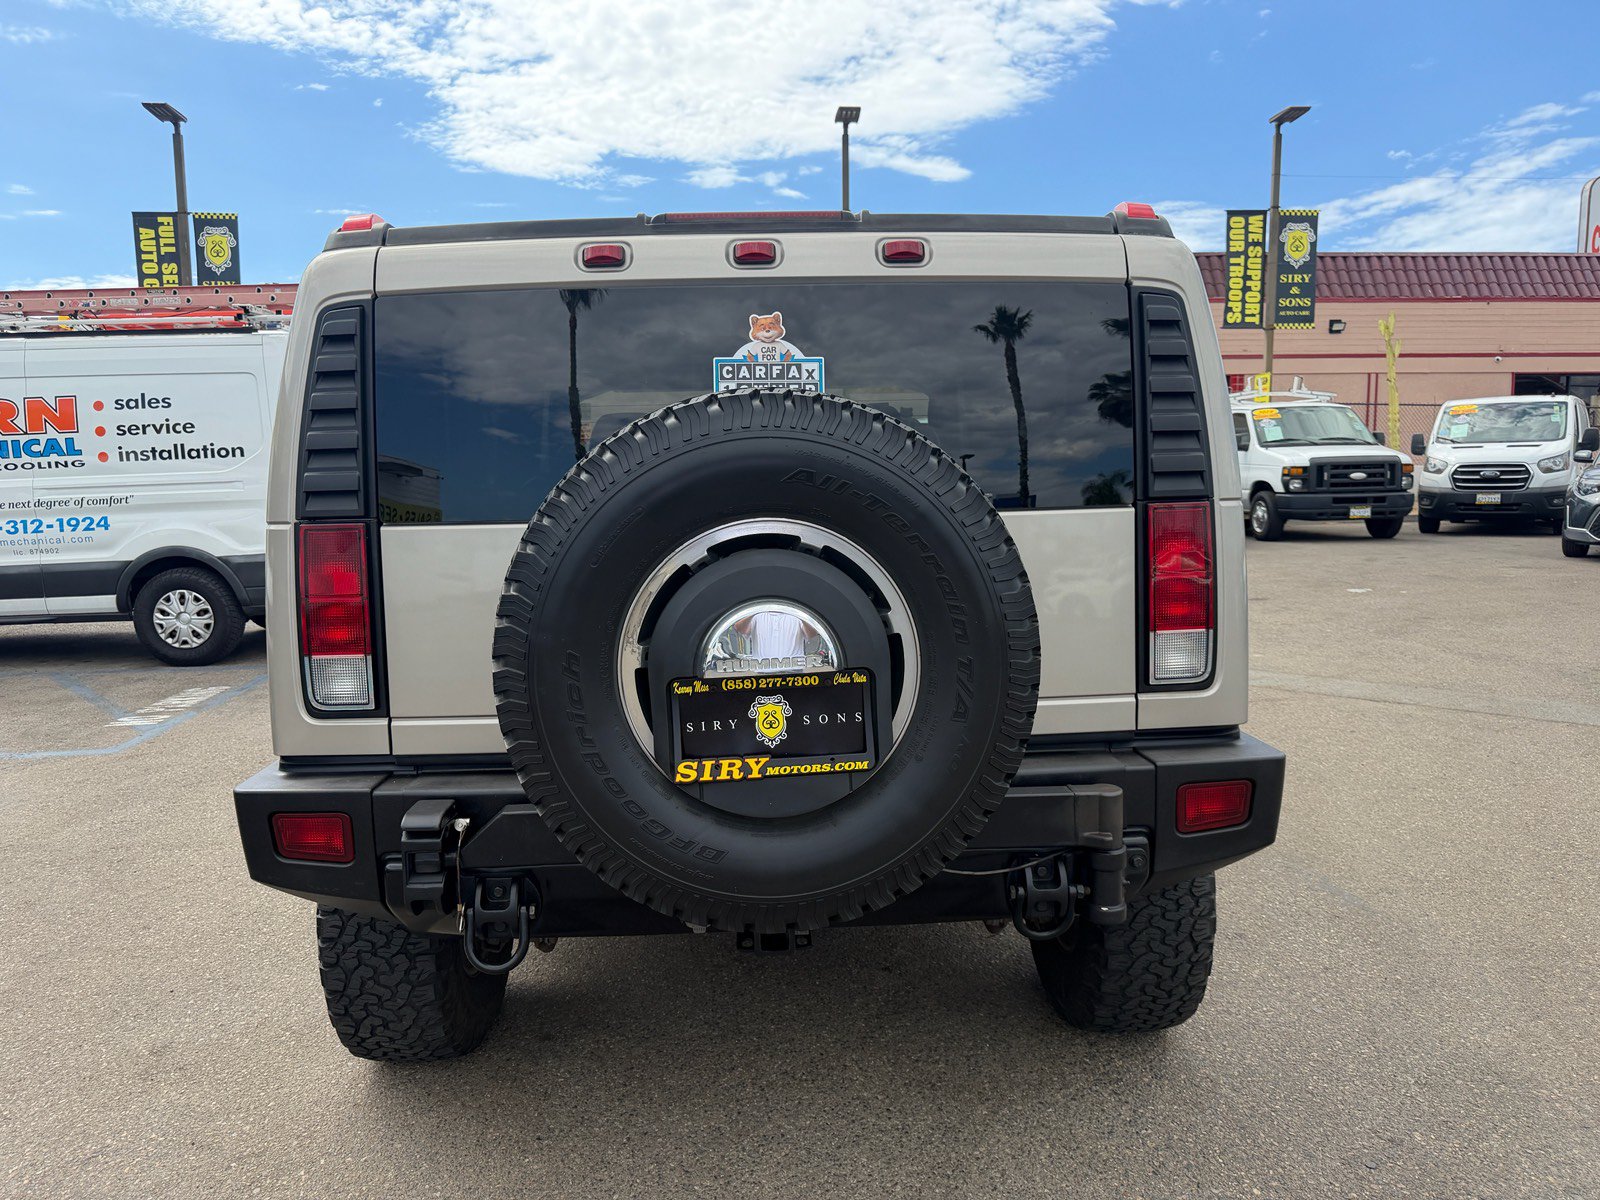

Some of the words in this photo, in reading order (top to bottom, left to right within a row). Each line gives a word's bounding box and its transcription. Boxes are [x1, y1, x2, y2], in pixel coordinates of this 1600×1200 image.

[157, 216, 176, 255] FULL
[1229, 216, 1245, 252] OUR
[1248, 214, 1264, 243] WE
[139, 227, 159, 274] AUTO
[1245, 245, 1262, 325] SUPPORT
[1280, 273, 1312, 283] SIRY
[1226, 255, 1245, 324] TROOPS
[1290, 285, 1301, 294] &
[1278, 297, 1311, 307] SONS
[760, 346, 777, 354] CAR
[761, 353, 777, 361] FOX
[722, 365, 816, 380] CARFAX
[114, 392, 172, 410] sales
[116, 418, 196, 436] service
[118, 442, 246, 462] installation
[0, 459, 86, 471] OOLING
[8, 500, 32, 509] next
[73, 497, 86, 508] of
[716, 655, 824, 674] HUMMER
[722, 678, 757, 691] (858)
[758, 675, 819, 689] 277-7300
[686, 719, 738, 733] SIRY
[803, 711, 863, 725] SONS
[562, 649, 730, 864] BFGoodrich
